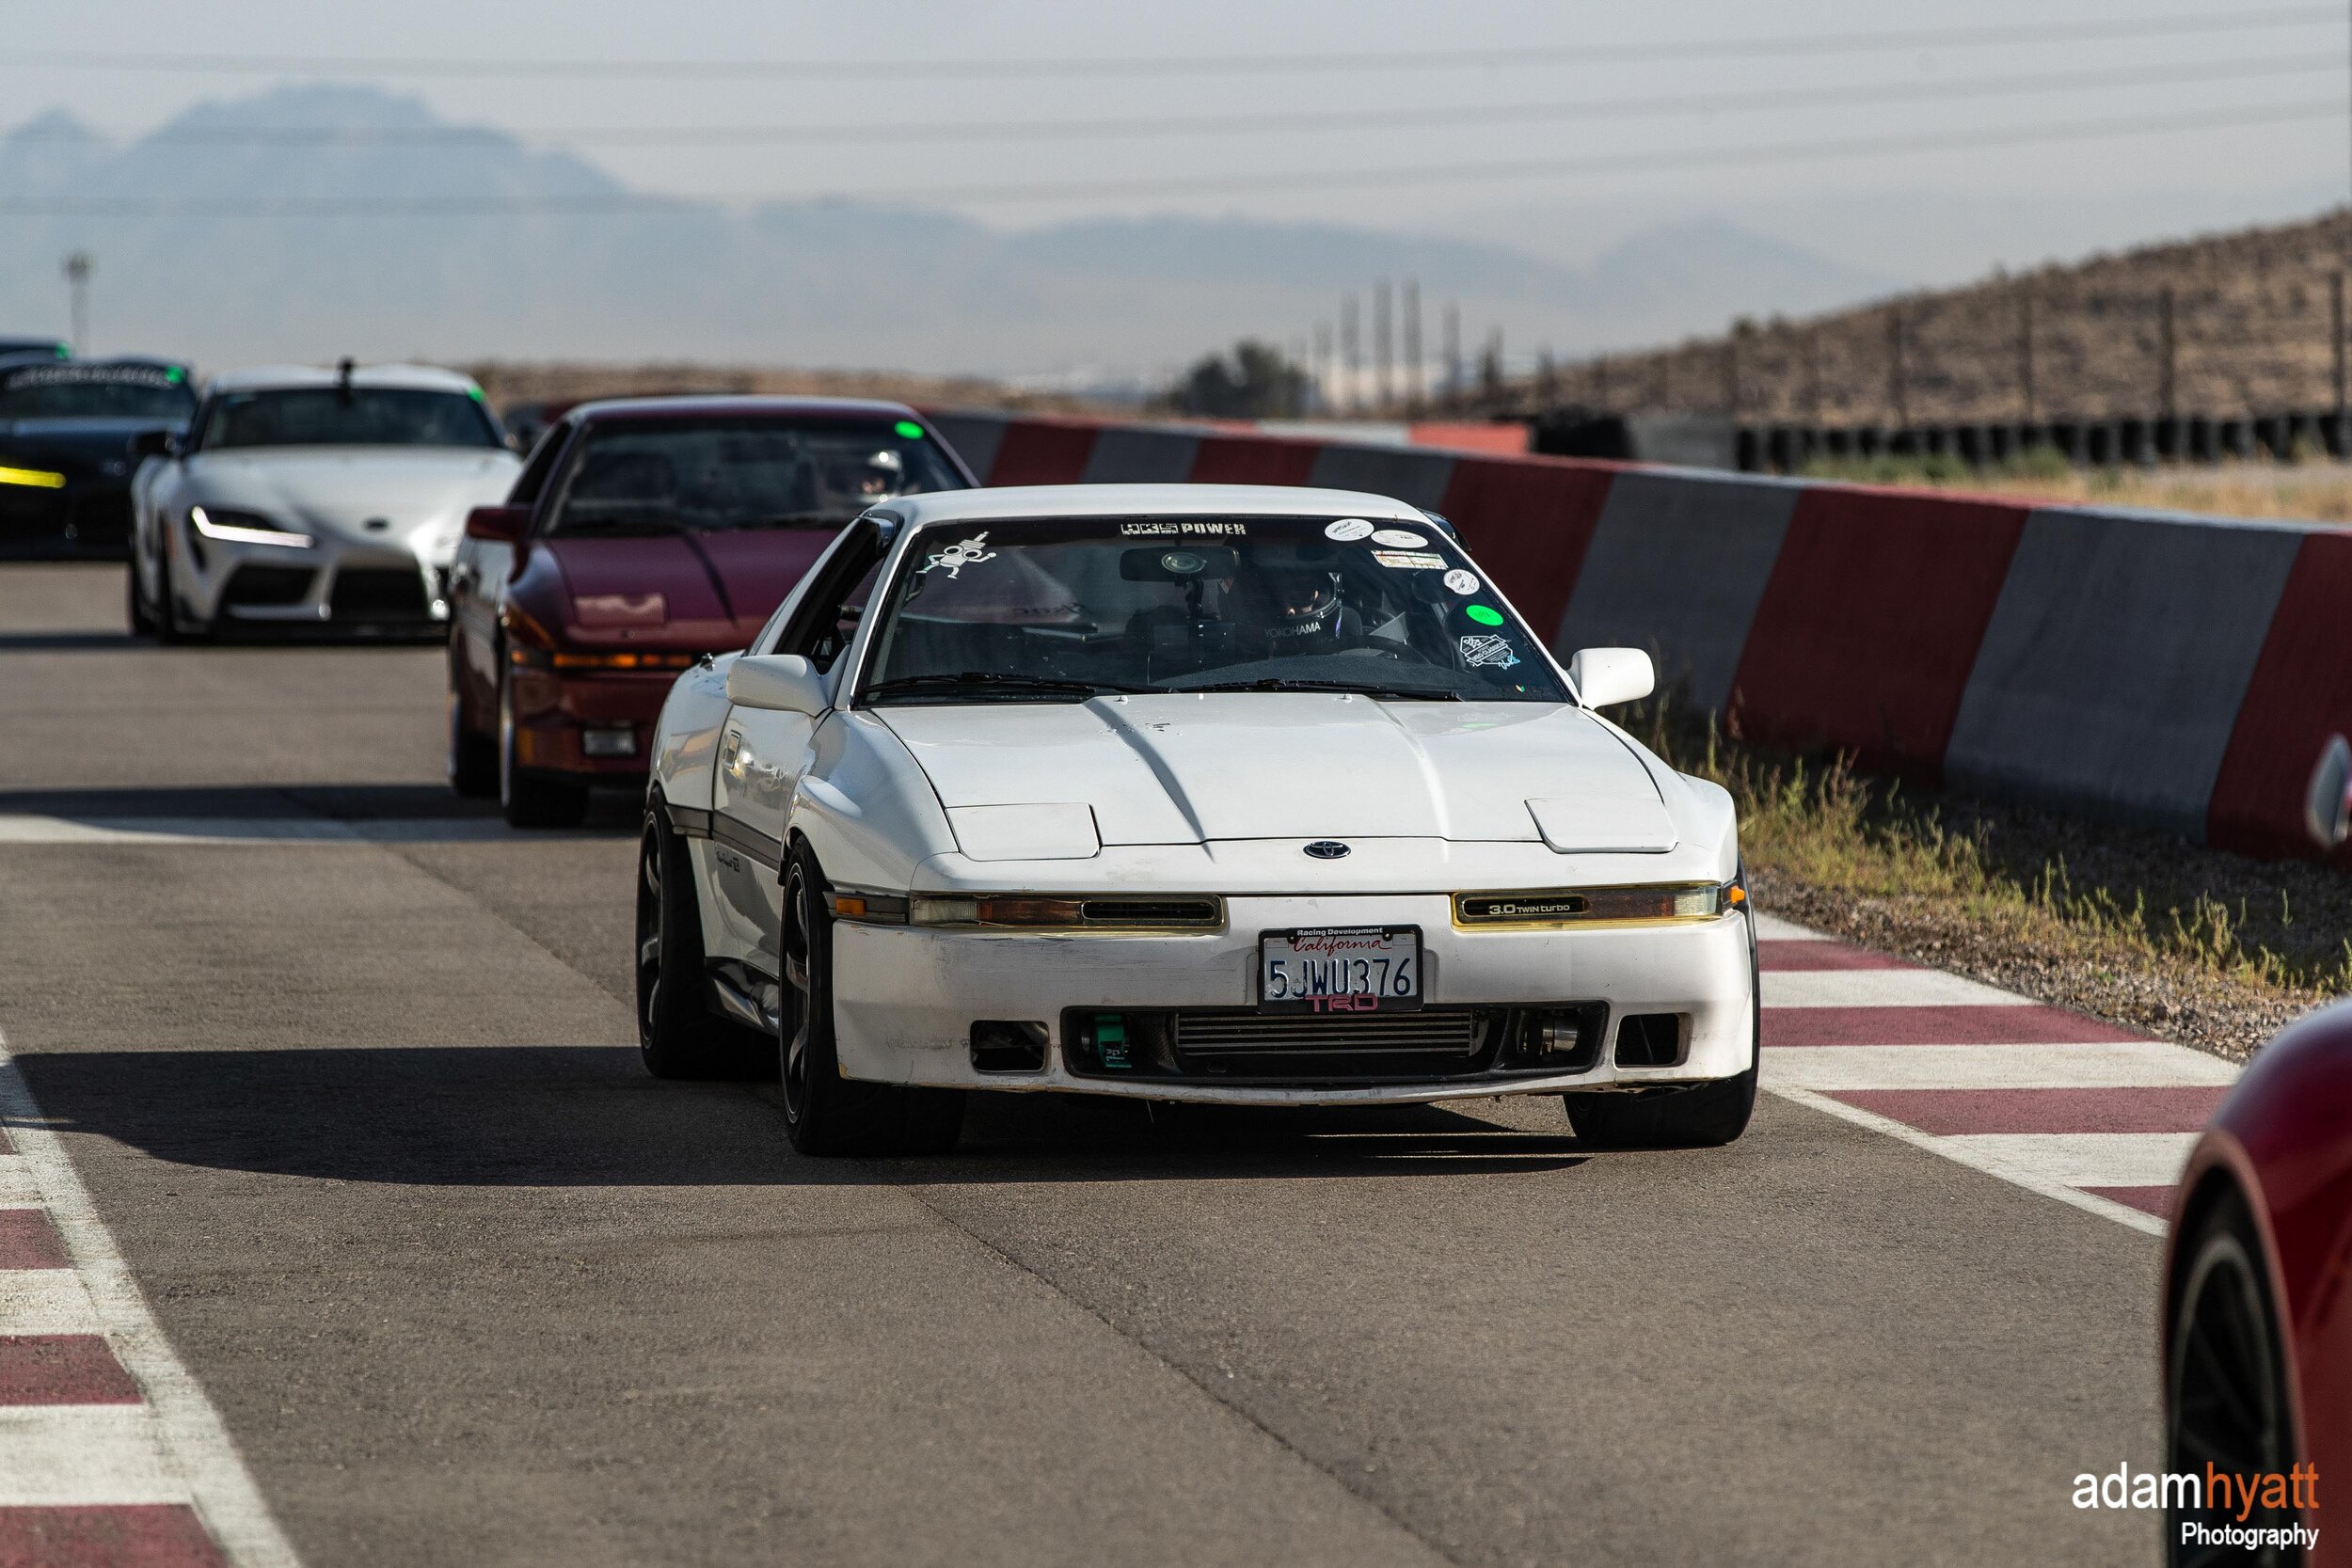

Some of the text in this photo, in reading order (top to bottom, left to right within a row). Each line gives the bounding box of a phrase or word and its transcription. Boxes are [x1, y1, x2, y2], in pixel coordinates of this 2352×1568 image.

[1181, 523, 1247, 535] POWER
[1263, 621, 1321, 639] YOKOHAMA
[1488, 904, 1516, 915] 3.0
[1296, 927, 1383, 937] Racing Development
[1293, 935, 1391, 958] California
[1270, 957, 1410, 999] 5JWU376
[1305, 992, 1378, 1012] TRD
